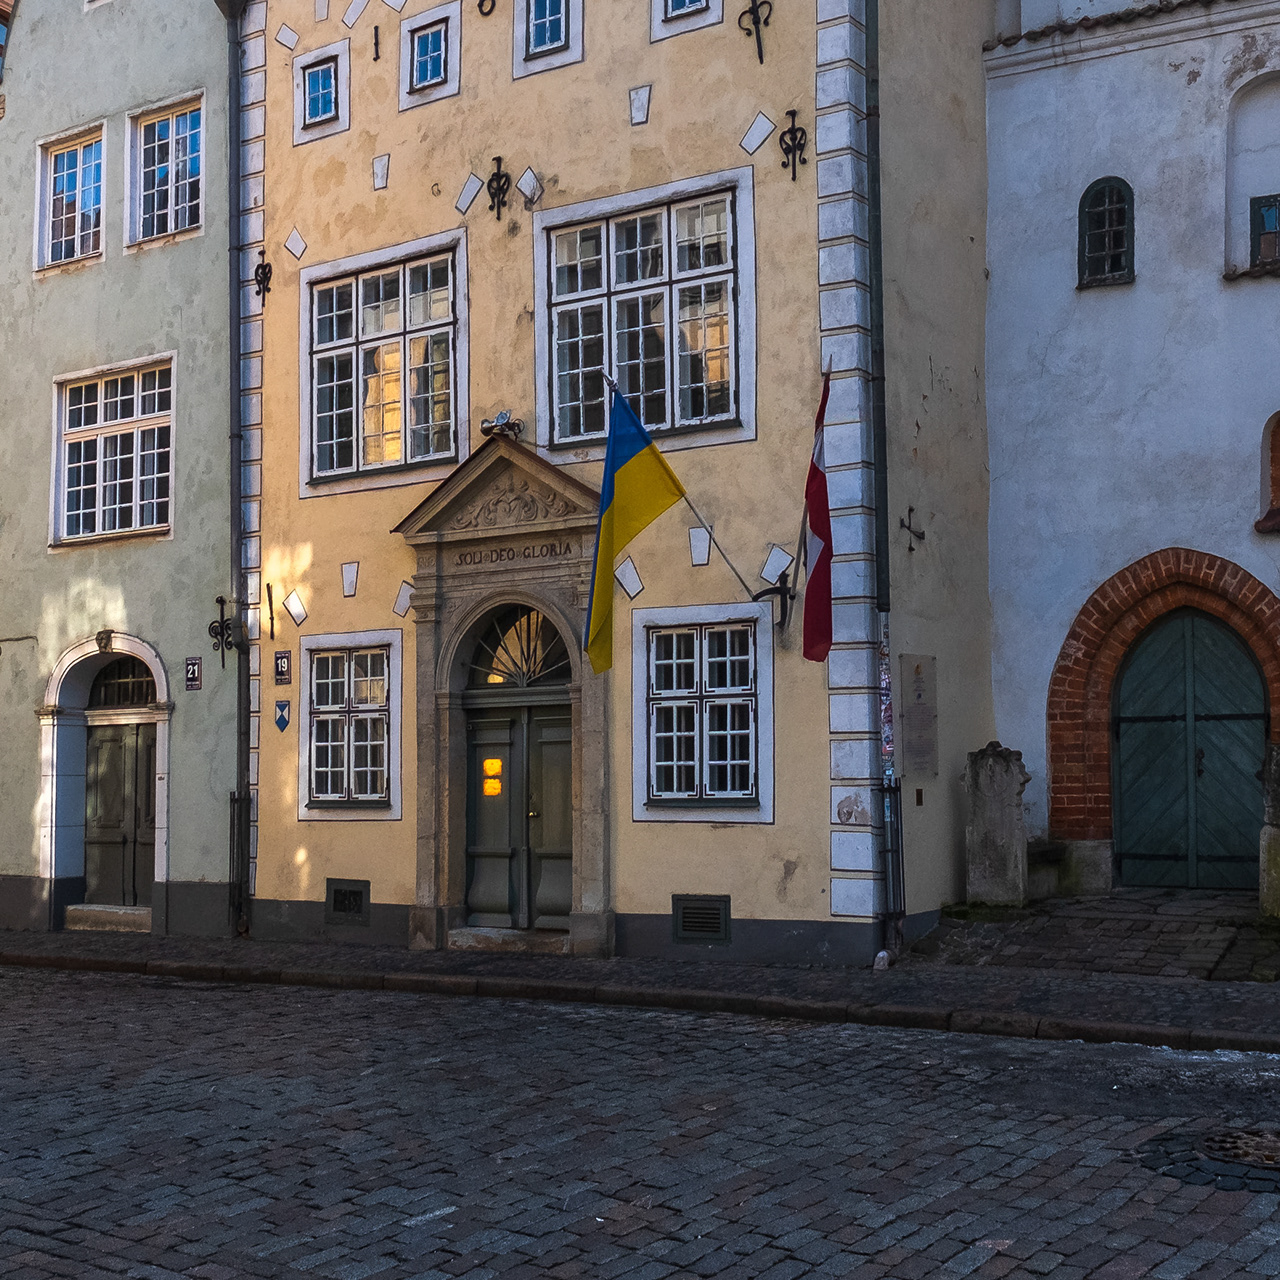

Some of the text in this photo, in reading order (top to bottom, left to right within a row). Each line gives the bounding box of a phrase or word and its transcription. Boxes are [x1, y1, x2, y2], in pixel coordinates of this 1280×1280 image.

[489, 548, 516, 564] DEO
[523, 542, 573, 559] GLORIA
[187, 664, 199, 678] 21
[276, 657, 288, 672] 19
